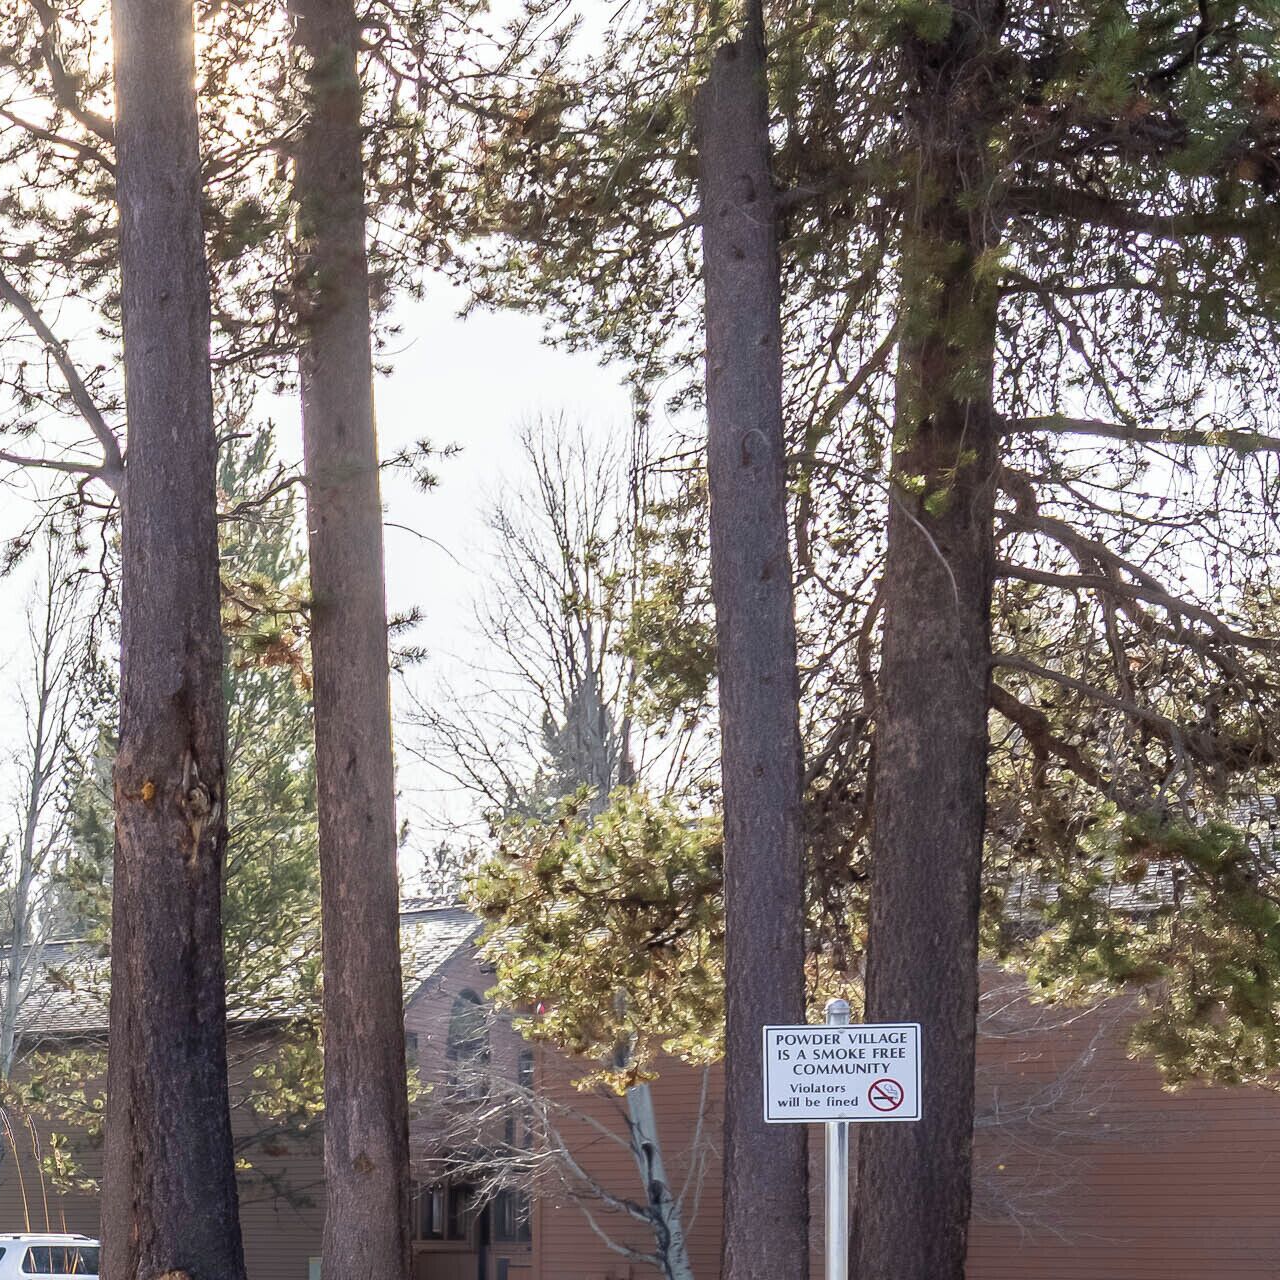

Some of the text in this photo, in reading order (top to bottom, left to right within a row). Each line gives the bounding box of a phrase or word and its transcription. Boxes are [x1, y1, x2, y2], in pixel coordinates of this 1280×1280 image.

[776, 1032, 907, 1045] POWDER VILLAGE
[778, 1047, 906, 1060] IS A SMOKE FREE
[793, 1063, 890, 1075] COMMUNITY
[790, 1083, 846, 1094] Violators
[777, 1096, 859, 1107] will be fined
